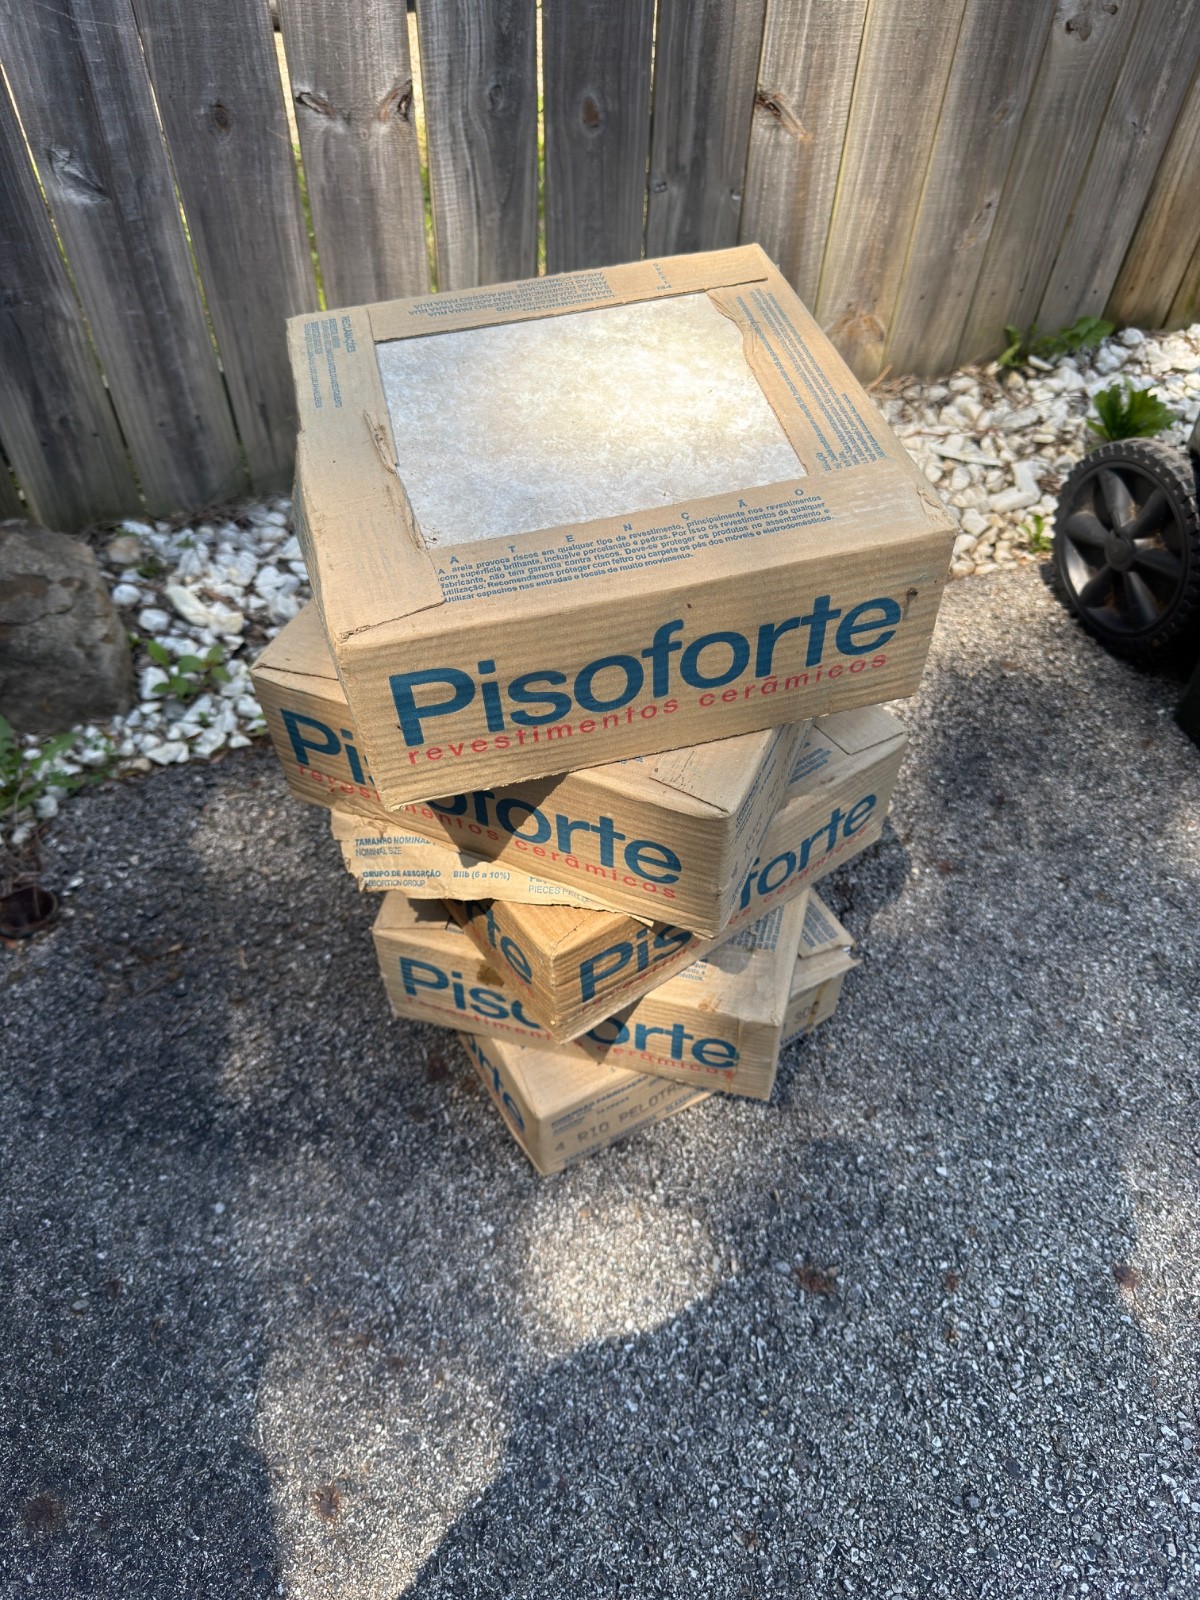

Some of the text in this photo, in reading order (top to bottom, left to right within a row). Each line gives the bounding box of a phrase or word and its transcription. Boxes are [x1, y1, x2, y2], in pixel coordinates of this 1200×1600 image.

[429, 304, 452, 312] PARA
[454, 298, 492, 308] ACESSO
[459, 293, 497, 302] ACESSO
[474, 300, 513, 309] ACESSO
[439, 575, 458, 583] com
[502, 556, 542, 571] brilhante,
[543, 549, 580, 562] inclusive
[582, 539, 631, 555] porcelanato
[639, 531, 670, 544] pedras.
[671, 527, 686, 536] Por
[688, 524, 706, 533] isso
[719, 510, 775, 526] revestimentos
[777, 507, 788, 515] de
[789, 500, 825, 514] qualquer
[451, 562, 472, 572] areia
[475, 556, 510, 569] provoca
[512, 549, 538, 560] riscos
[556, 538, 593, 552] qualquer
[595, 534, 612, 544] tipo
[628, 520, 683, 538] revestimento,
[685, 508, 745, 527] principalmente
[765, 492, 821, 509] revestimentos
[488, 572, 505, 581] não
[508, 568, 525, 577] tem
[527, 560, 562, 574] garantia
[564, 555, 591, 566] contra
[593, 548, 622, 560] riscos.
[624, 541, 657, 553] Deve-se
[660, 534, 695, 548] proteger
[711, 523, 749, 537] produtos
[764, 508, 821, 525] assentamento
[487, 570, 554, 589] Recomendamos
[592, 560, 610, 568] com
[611, 554, 633, 564] feltro
[647, 545, 678, 558] carpete
[691, 539, 707, 549] pés
[708, 536, 723, 544] dos
[724, 530, 754, 541] móveis
[445, 593, 474, 604] Utilizar
[476, 584, 518, 600] capachos
[535, 573, 571, 586] entradas
[580, 567, 605, 577] locais
[606, 564, 617, 572] de
[618, 559, 643, 570] muito
[643, 549, 693, 565] movimento.
[389, 594, 902, 747] Pisoforte
[408, 654, 888, 765] revestimentos cerâmicos
[355, 836, 392, 846] TAMANHO
[362, 870, 390, 878] GRUPO
[391, 870, 401, 878] DE
[402, 869, 442, 879] ABSORÇÃO
[489, 871, 511, 881] 10%)
[513, 839, 676, 900] cerâmicos
[402, 879, 426, 887] GROUP
[528, 885, 561, 894] PIECES
[576, 1121, 610, 1144] RIO
